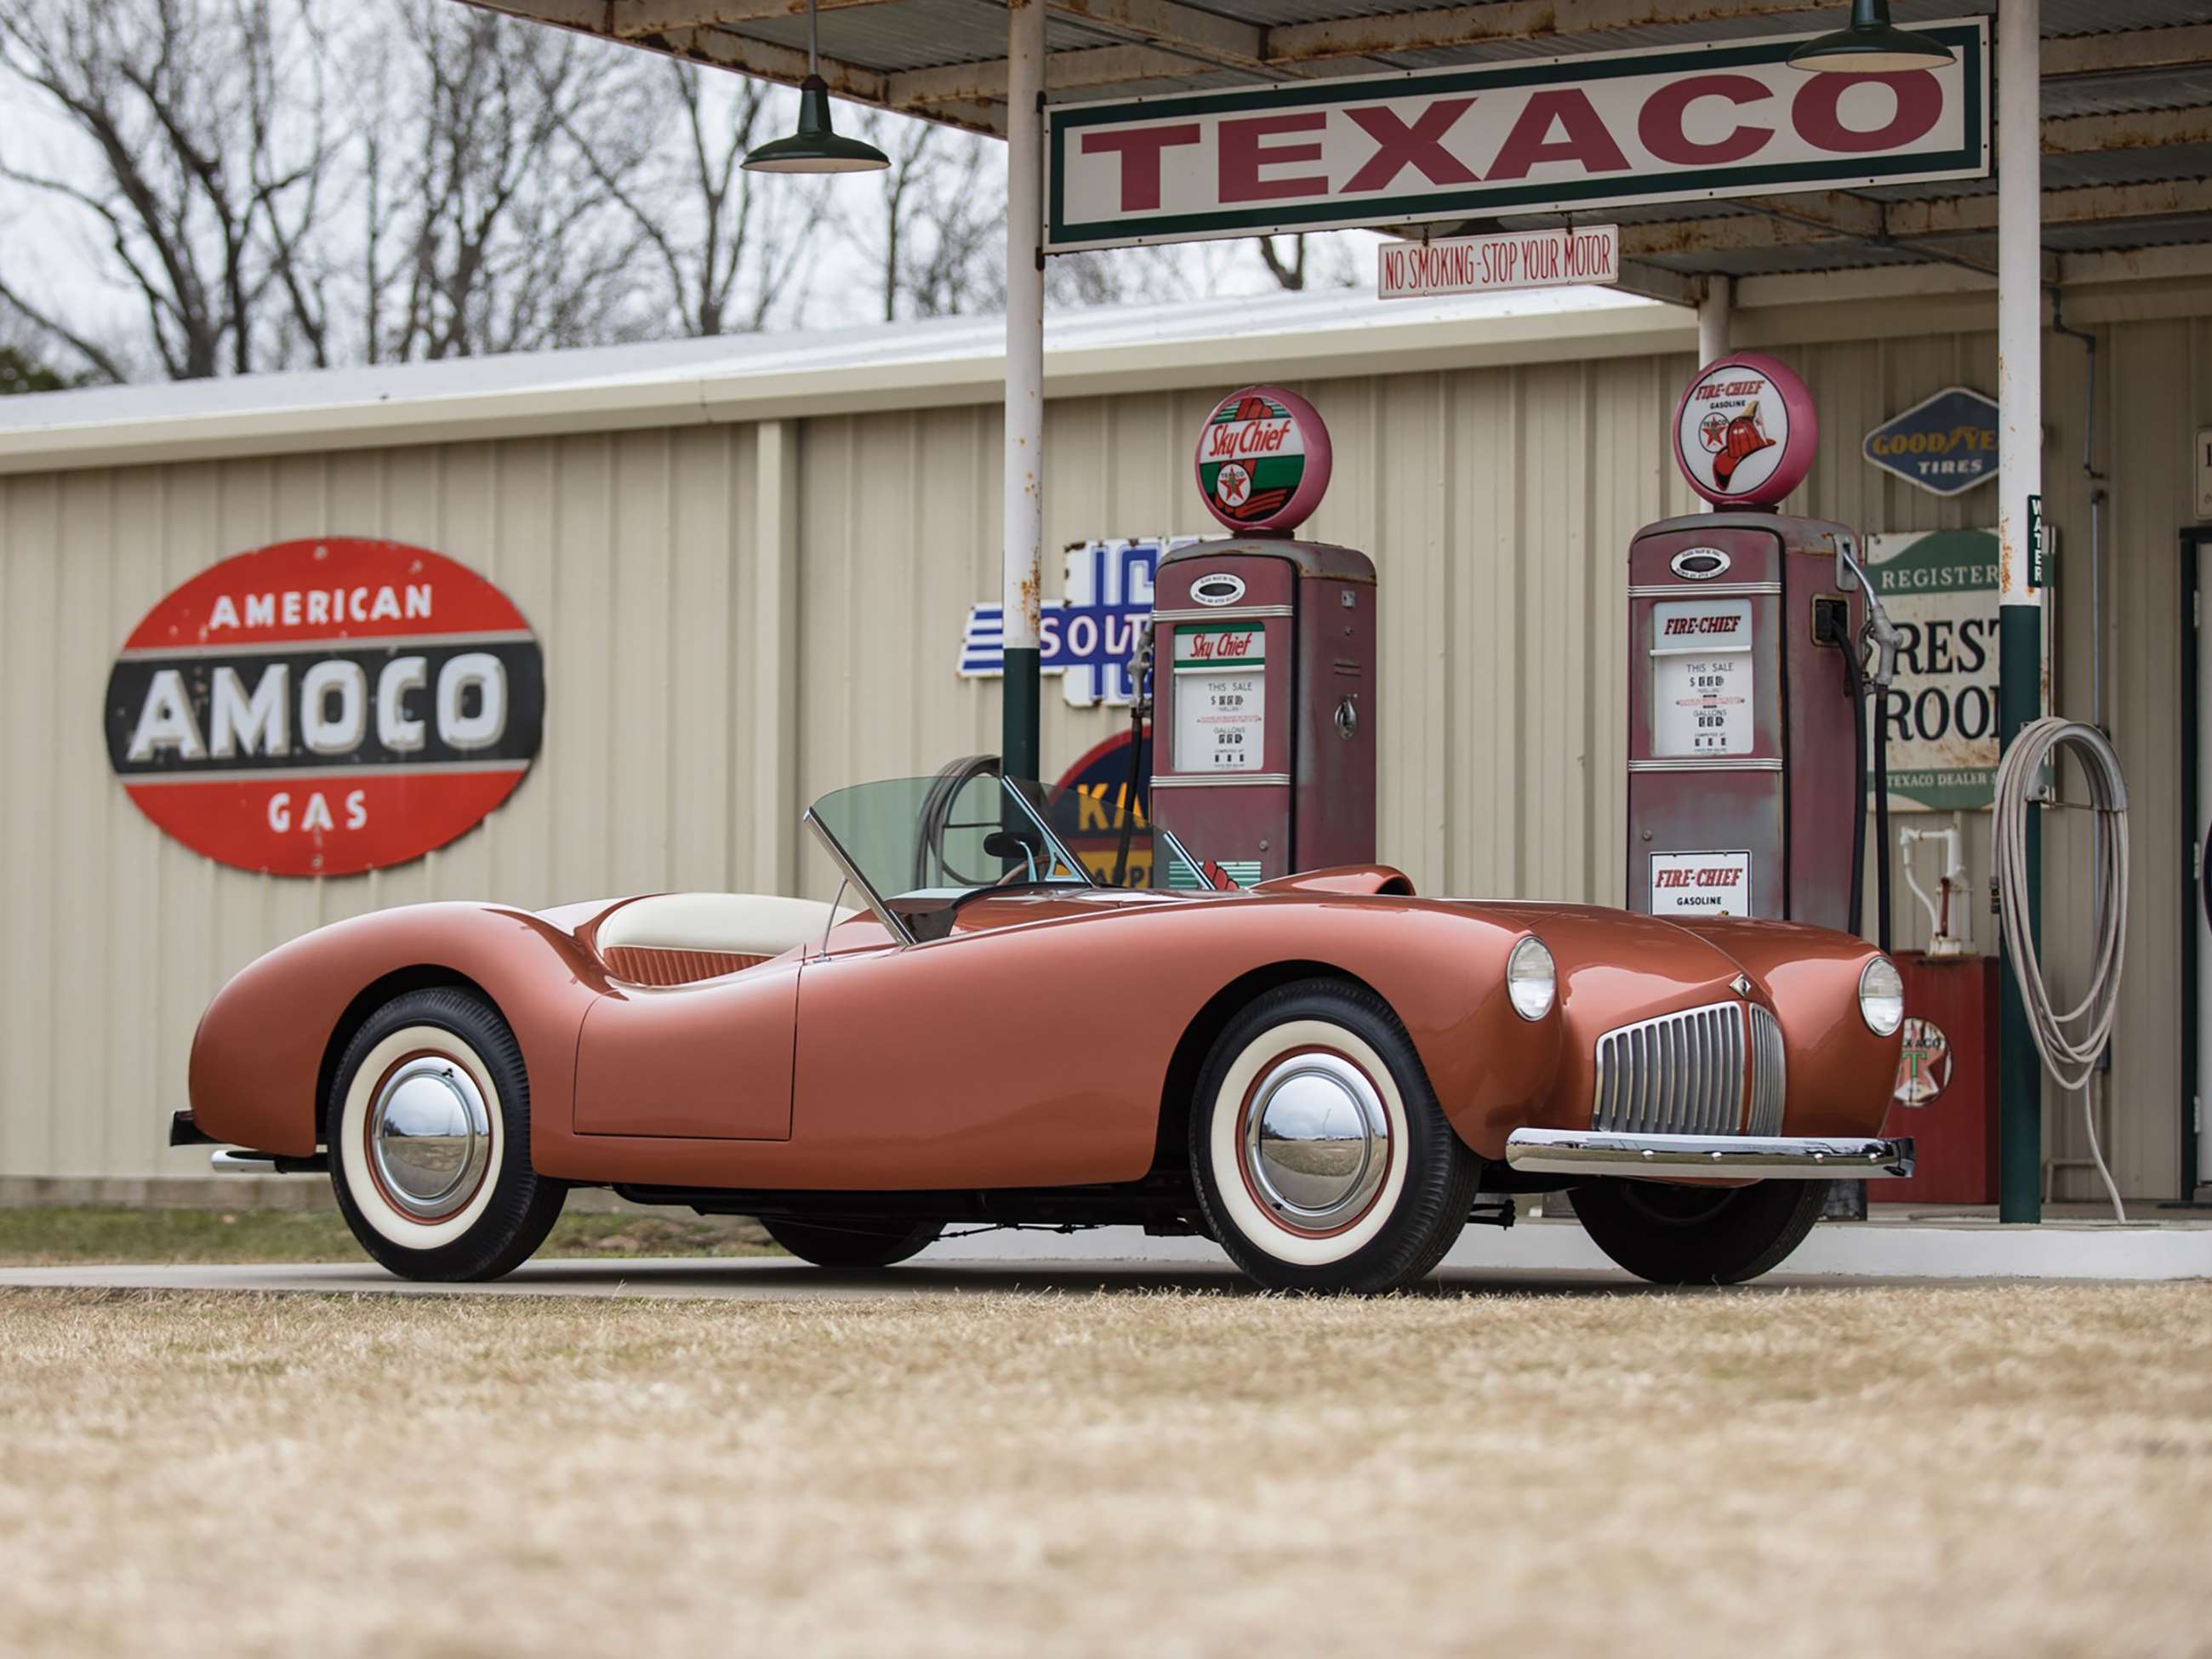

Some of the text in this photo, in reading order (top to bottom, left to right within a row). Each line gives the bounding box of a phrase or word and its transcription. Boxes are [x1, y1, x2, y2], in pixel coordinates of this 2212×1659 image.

[1081, 71, 1943, 213] TEXACO
[1385, 250, 1404, 290] NO
[1521, 237, 1559, 280] YOUR
[1564, 234, 1611, 277] MOTOR
[1695, 380, 1765, 401] FIRE-CHIEF
[1709, 400, 1746, 409] GASOLINE
[1209, 419, 1291, 459] Sky Chief
[1873, 427, 1999, 454] GOODYE
[1918, 459, 1982, 474] TIRES
[2032, 499, 2042, 582] WATER
[1881, 565, 2000, 589] REGISTER
[209, 584, 432, 630] AMERICAN
[1040, 613, 1150, 658] SOUT
[1664, 615, 1741, 635] FIRE-CHIEF
[1189, 632, 1252, 659] Sky Chief
[1686, 662, 1734, 672] THIS SALE
[1208, 681, 1253, 692] THIS SALE
[127, 653, 508, 762] AMOCO
[1937, 772, 1987, 785] DEALER
[268, 790, 368, 833] GAS
[1077, 782, 1147, 832] KA
[1655, 869, 1742, 887] FIRE-CHIEF
[1677, 897, 1722, 905] GASOLINE
